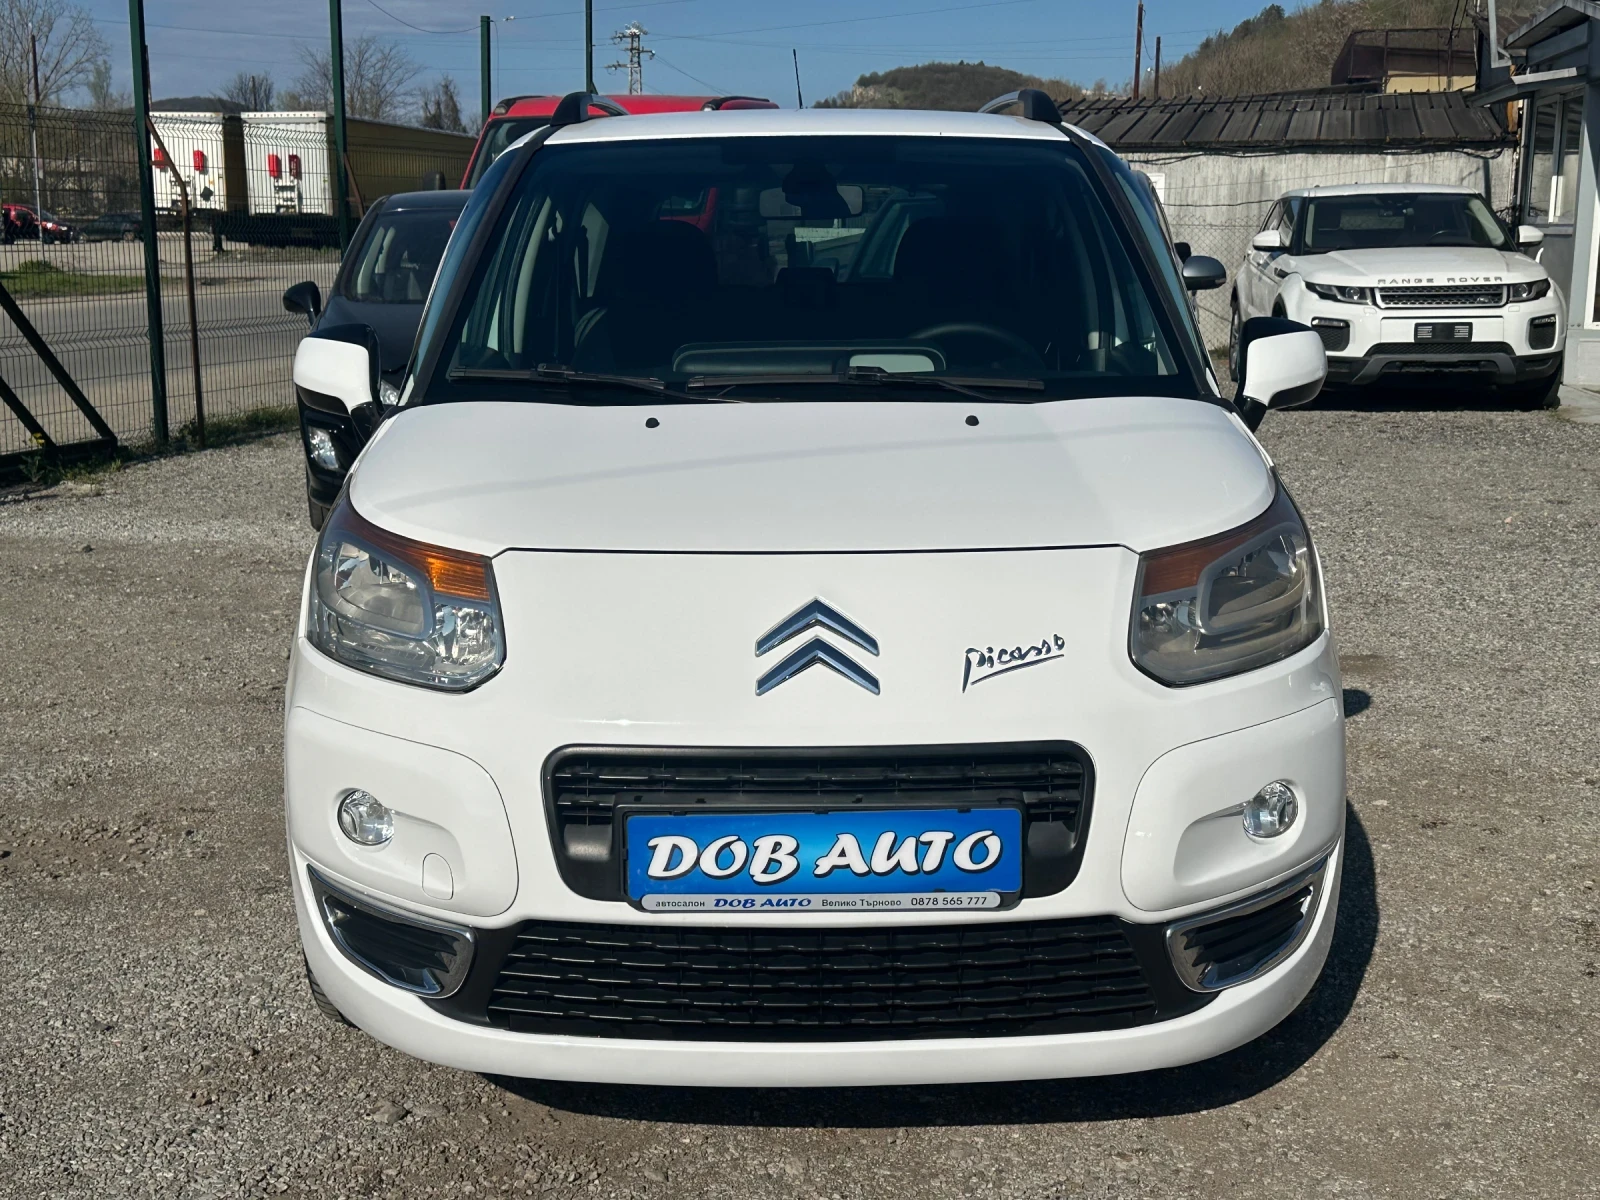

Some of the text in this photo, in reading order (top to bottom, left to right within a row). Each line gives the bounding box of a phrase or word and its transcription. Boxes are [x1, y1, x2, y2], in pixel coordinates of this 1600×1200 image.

[1377, 277, 1435, 285] RANGE
[647, 829, 1004, 886] DOB AUTO
[655, 900, 706, 908] автосалон
[713, 897, 812, 909] DOB AUTO
[821, 898, 902, 908] Велико Търново
[910, 895, 988, 906] 0878 565 777
